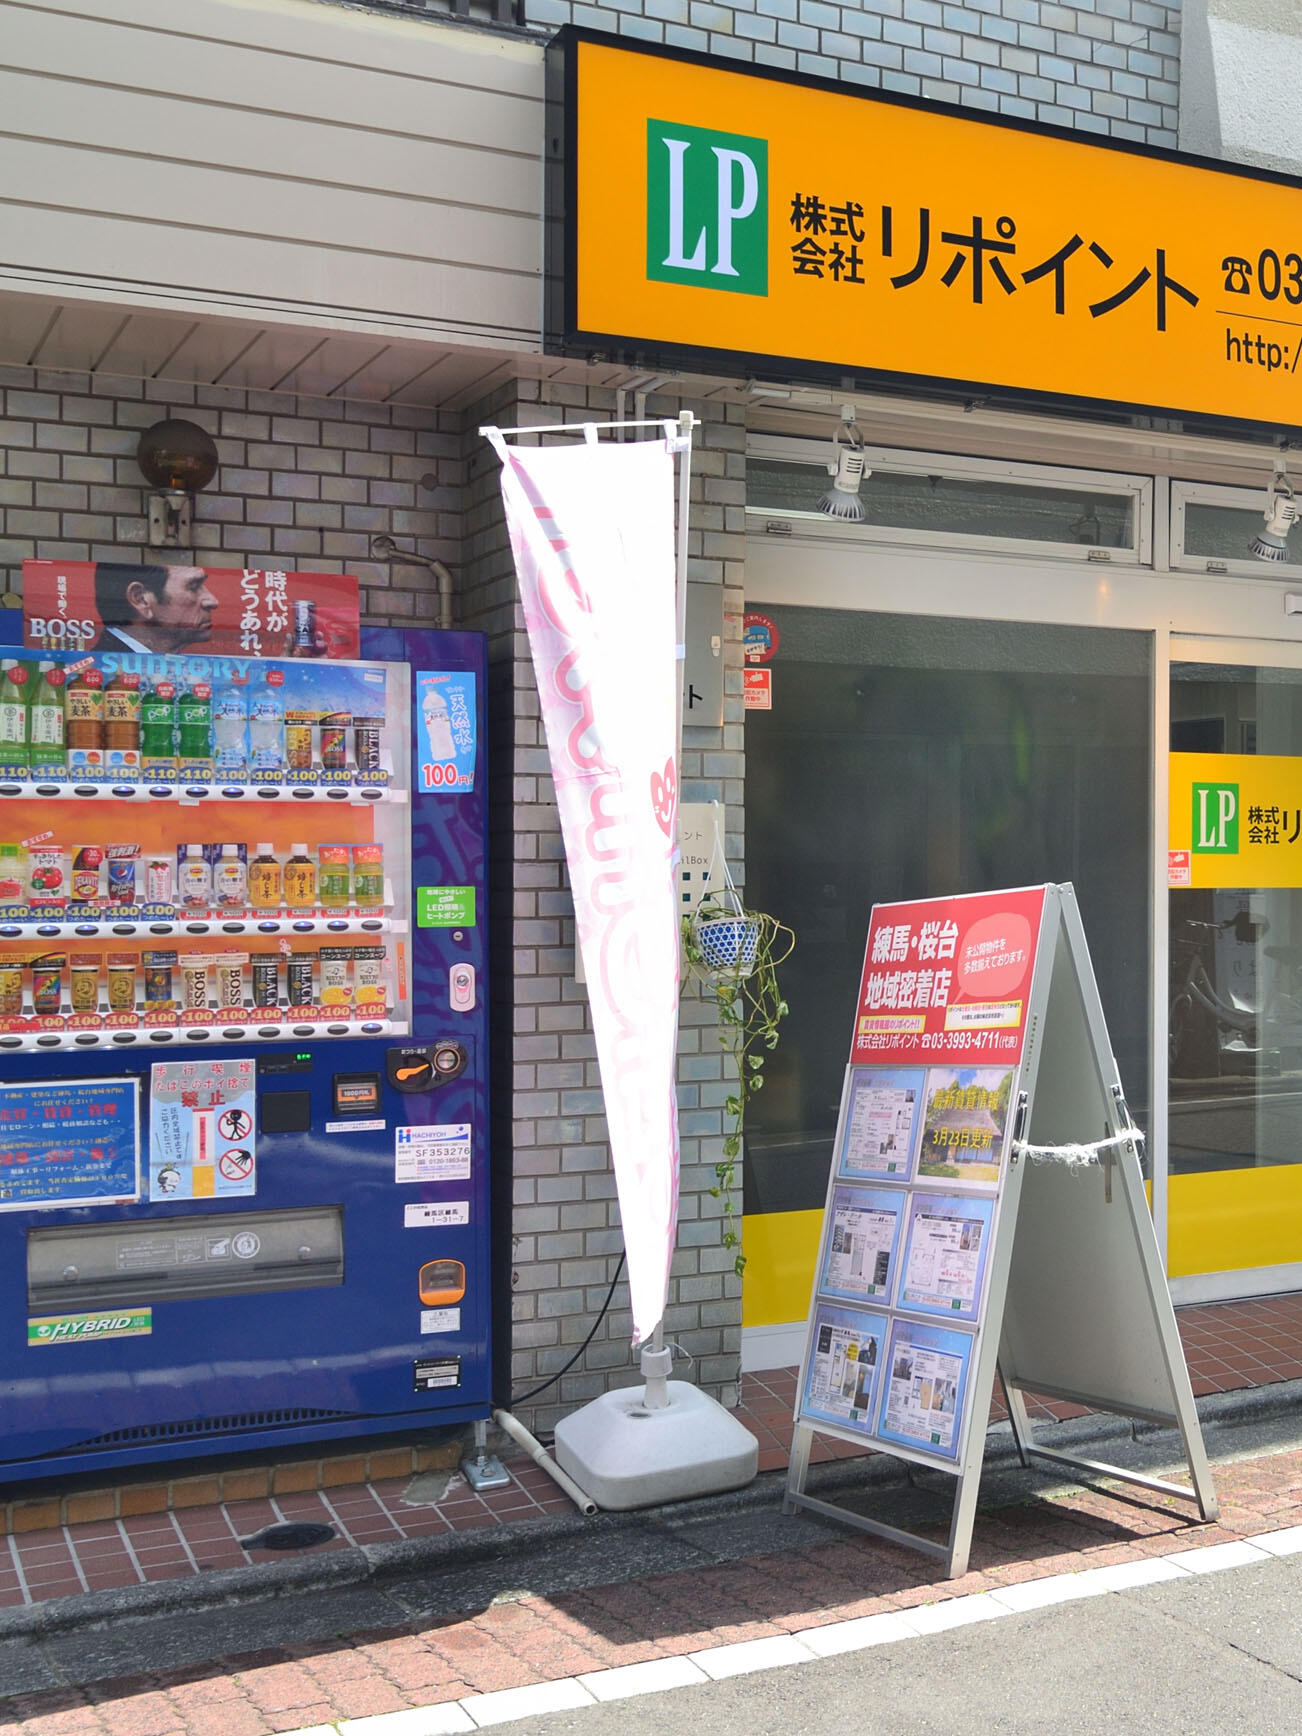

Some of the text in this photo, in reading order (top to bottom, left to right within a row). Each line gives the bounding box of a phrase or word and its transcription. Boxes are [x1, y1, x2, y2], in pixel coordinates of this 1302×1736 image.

[661, 137, 759, 276] LP
[790, 192, 865, 243] 株式
[791, 239, 865, 284] 会社
[881, 205, 1199, 332] リポイント
[264, 571, 288, 632] 時代が
[30, 618, 95, 638] BOSS
[101, 653, 252, 677] SUNTORY
[1198, 789, 1236, 848] LP
[1248, 806, 1280, 825] 株式
[1249, 826, 1280, 844] 会社
[871, 920, 959, 963] 練馬・桜台
[194, 971, 206, 1008] BOSS
[230, 969, 241, 1006] BOSS
[266, 967, 276, 1005] BLACK
[301, 966, 311, 1004] BLACK
[864, 968, 952, 1009] 地域密着店
[182, 1090, 226, 1107] 禁止
[49, 1317, 132, 1341] HYBRID
